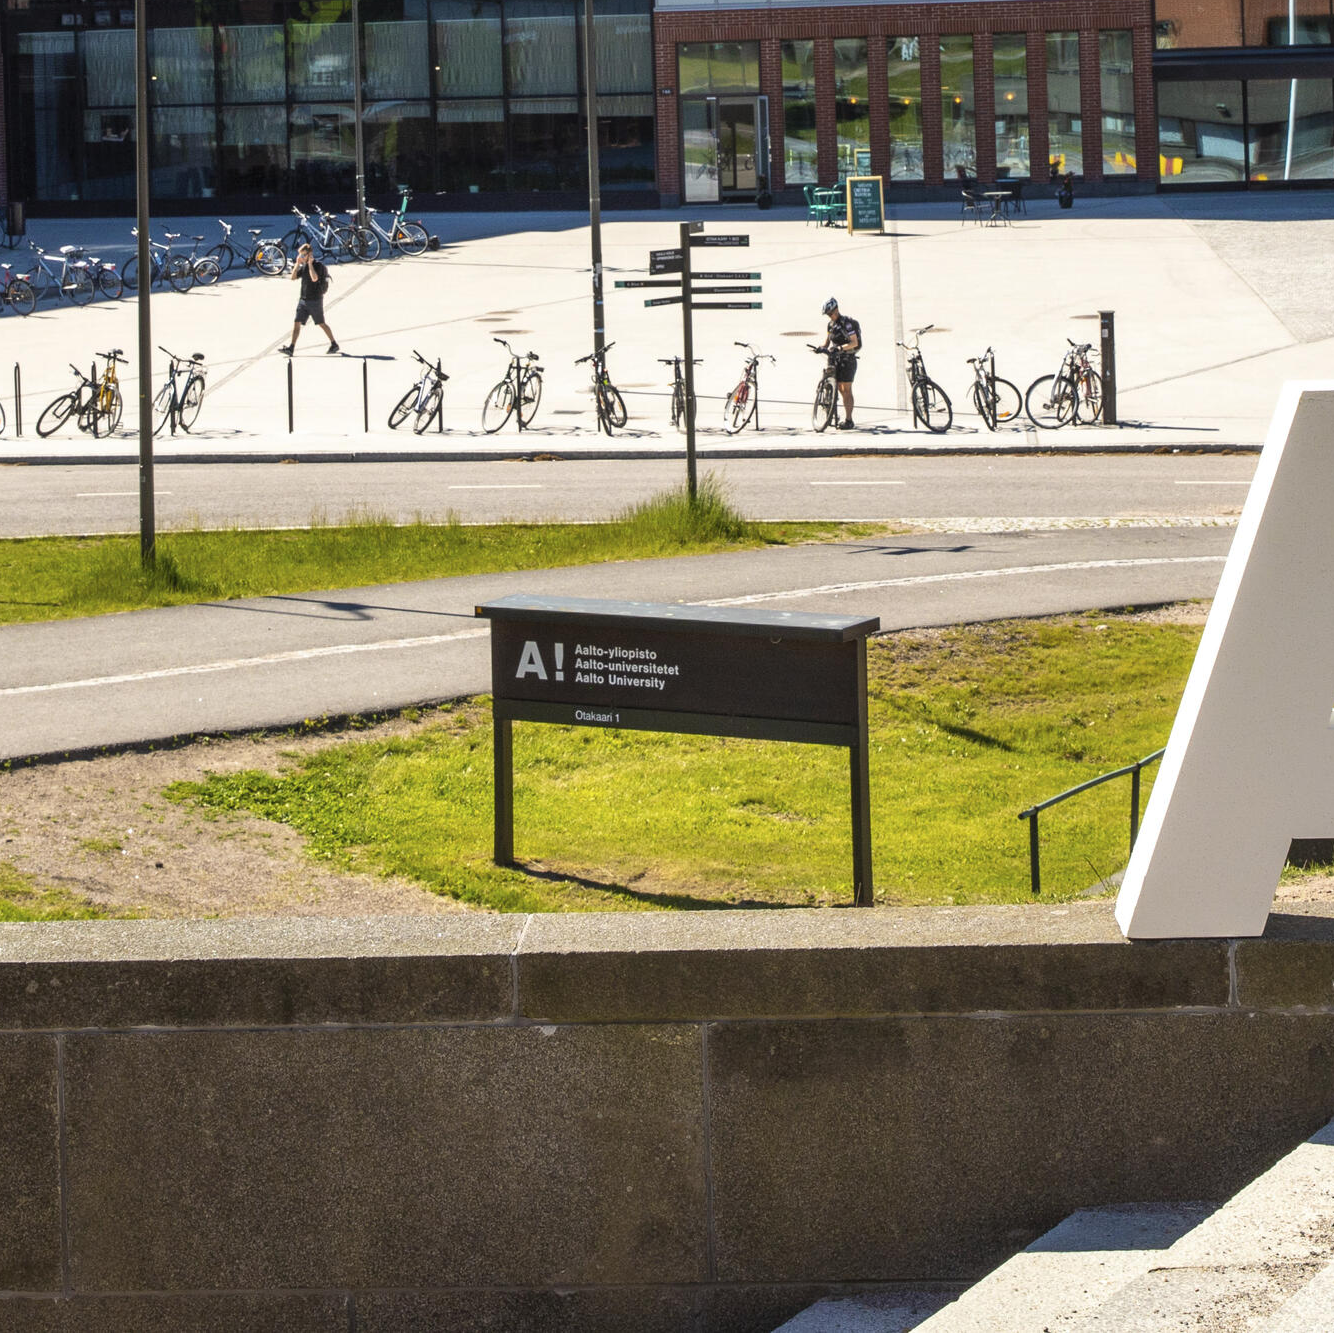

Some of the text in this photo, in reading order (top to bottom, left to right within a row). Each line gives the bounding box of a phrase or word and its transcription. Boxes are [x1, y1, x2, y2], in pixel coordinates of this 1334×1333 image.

[515, 640, 565, 681] A!
[575, 644, 657, 660] Aalto-yliopisto
[575, 658, 679, 675] Aalto-universitetet
[575, 672, 666, 691] Aalto University
[575, 709, 620, 723] Otakaari 1
